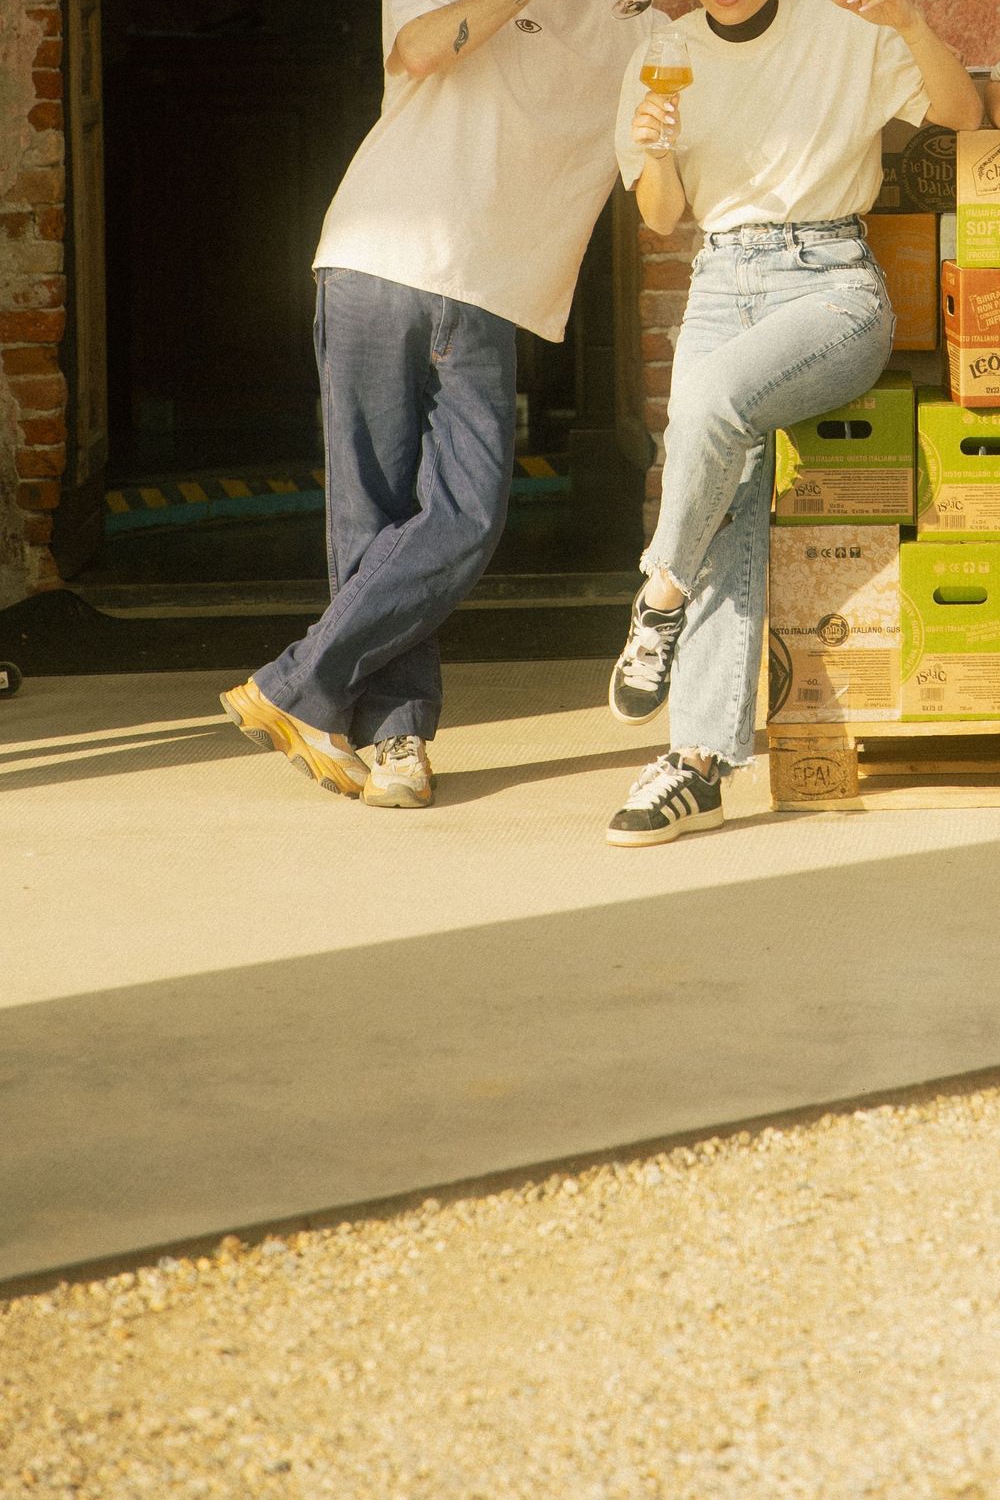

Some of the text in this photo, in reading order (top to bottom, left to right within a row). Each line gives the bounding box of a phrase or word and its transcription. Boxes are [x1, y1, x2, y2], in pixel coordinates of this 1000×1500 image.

[968, 251, 999, 259] PRODUCT
[976, 302, 994, 314] NON
[850, 626, 883, 635] ITALIANO
[886, 626, 900, 634] GUS
